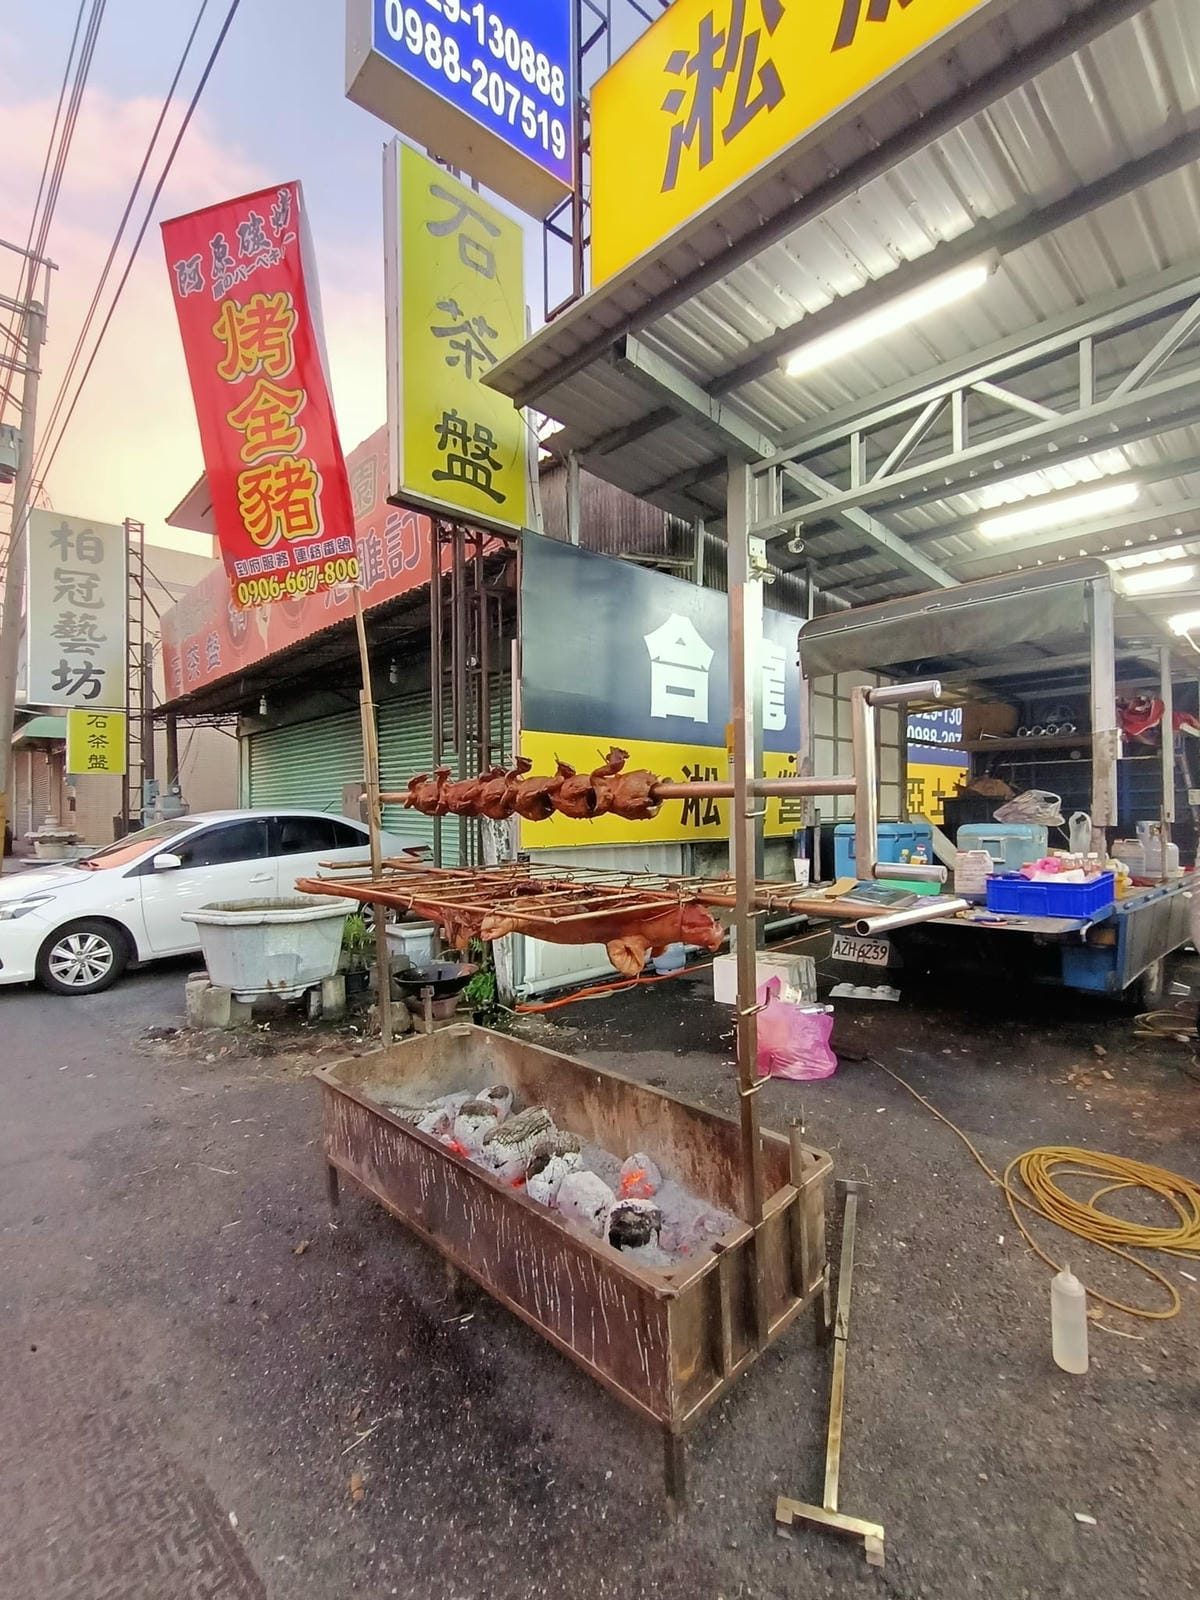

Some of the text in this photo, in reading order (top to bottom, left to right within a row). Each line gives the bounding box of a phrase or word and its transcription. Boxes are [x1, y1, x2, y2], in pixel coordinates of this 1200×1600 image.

[385, 0, 566, 160] 0988-207519
[425, 183, 506, 504] 石茶盤
[212, 292, 326, 549] 烤全豬
[49, 520, 108, 700] 柏冠藝坊
[234, 550, 290, 577] 到府服務
[237, 556, 361, 606] 0906-667-800
[87, 714, 110, 771] 石茶盤
[833, 940, 888, 960] AZH-6239
